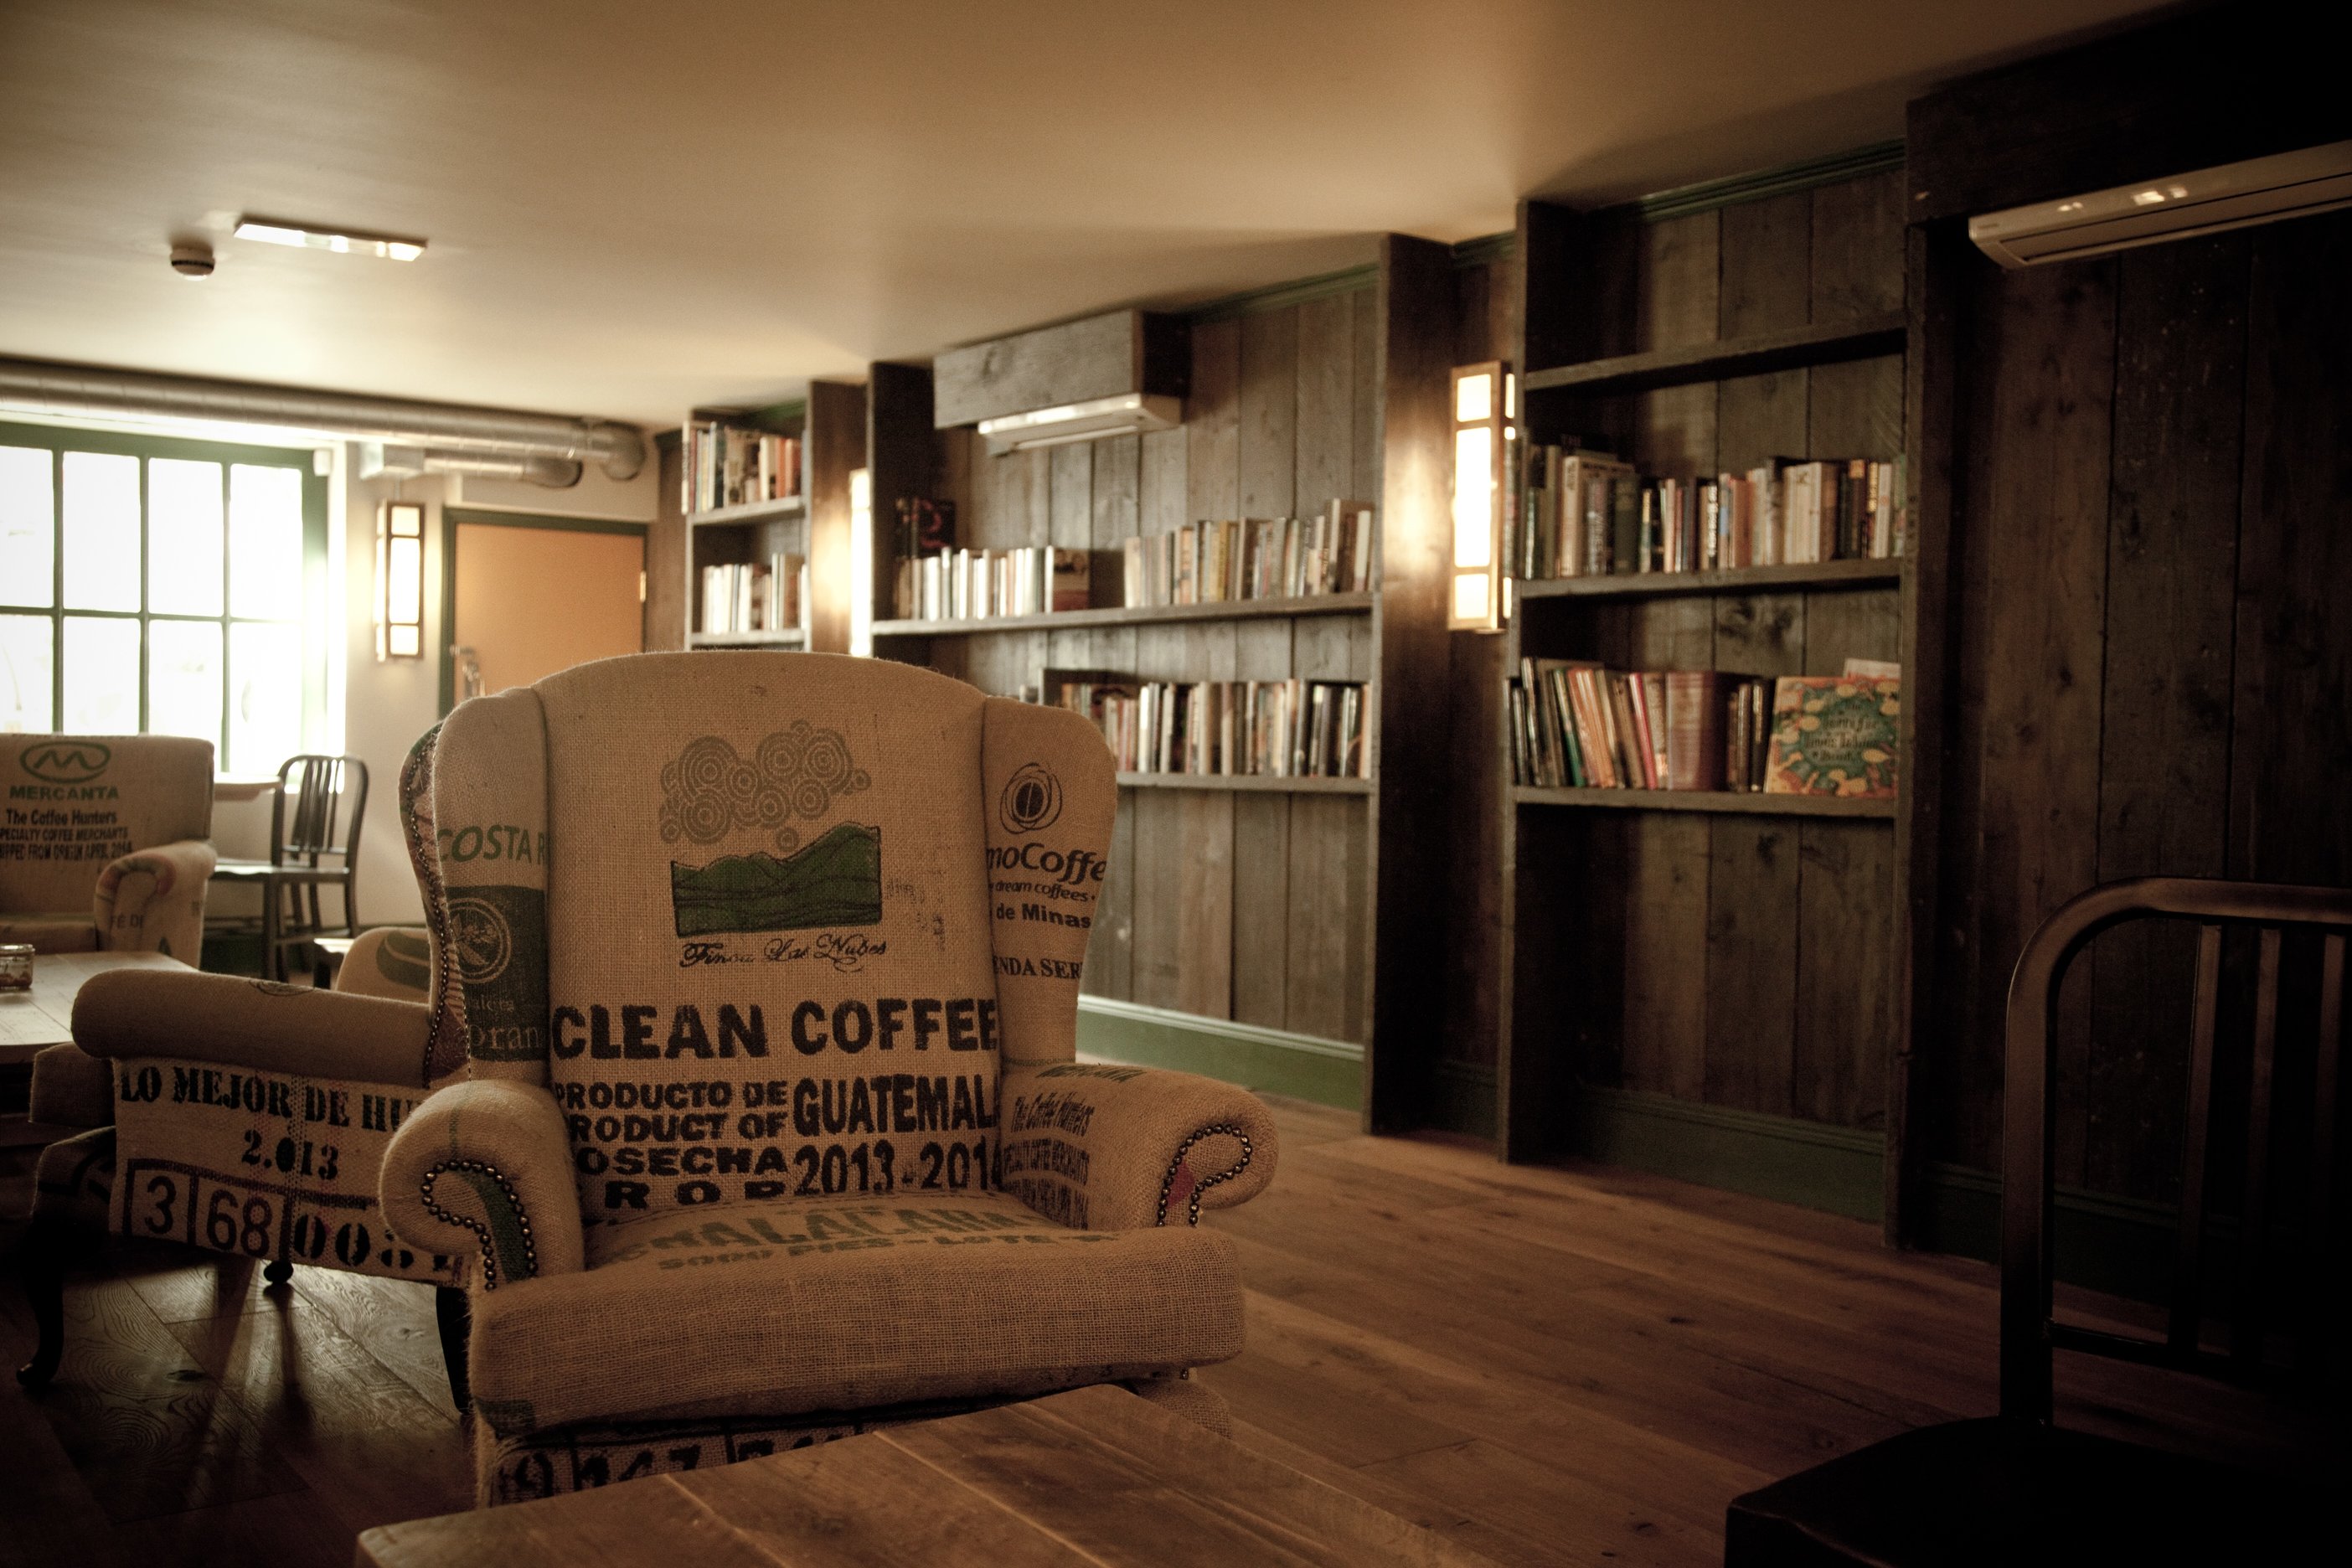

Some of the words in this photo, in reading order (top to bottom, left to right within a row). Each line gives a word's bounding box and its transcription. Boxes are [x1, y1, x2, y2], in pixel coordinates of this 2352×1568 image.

[9, 785, 119, 800] MERCANTA
[7, 808, 27, 825] The
[31, 809, 68, 825] Coffee
[71, 808, 117, 824] Hunters
[43, 828, 74, 842] COFFEE
[996, 903, 1015, 920] de
[1022, 904, 1091, 929] Minas
[551, 1003, 770, 1060] CLEAN
[790, 998, 998, 1056] COFFEE
[120, 1065, 163, 1103] LO
[171, 1066, 293, 1119] MEJOR
[304, 1085, 350, 1128] DE
[742, 1081, 788, 1108] DE
[570, 1112, 728, 1142] RODUCT
[737, 1112, 789, 1141] OF
[576, 1146, 789, 1177] OSECHA
[144, 1175, 178, 1235] 3
[206, 1188, 275, 1258] 68
